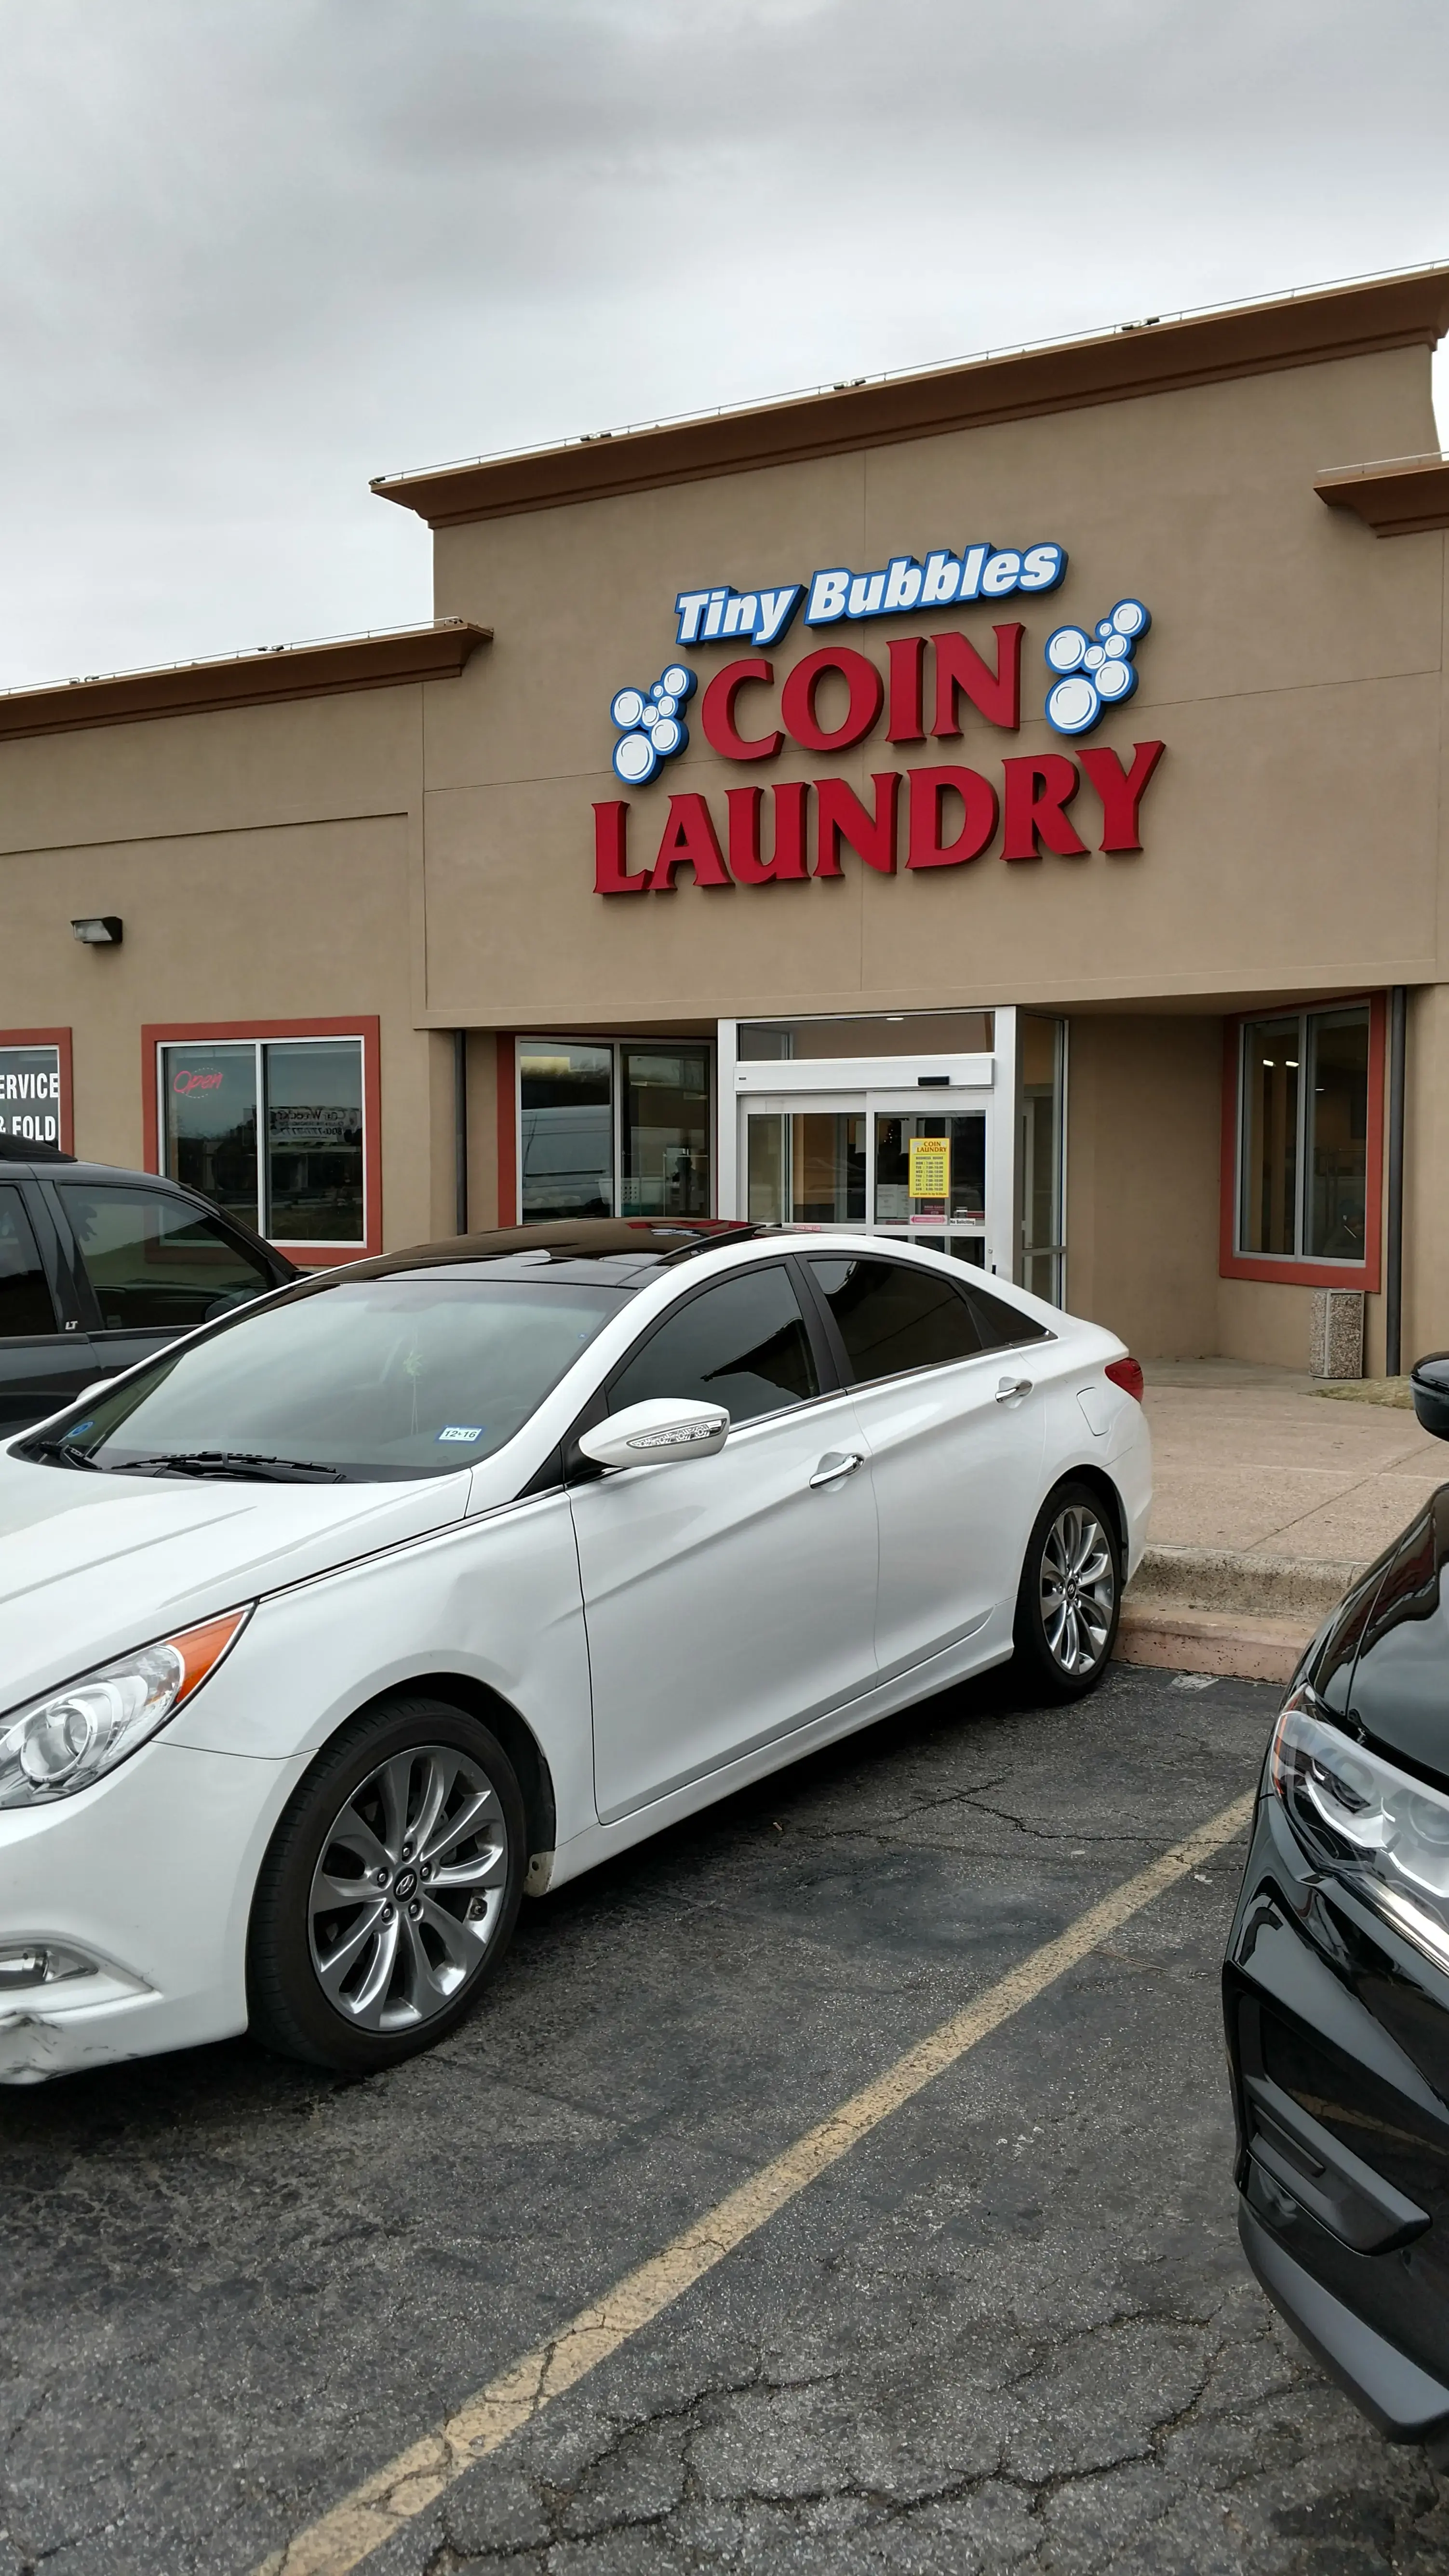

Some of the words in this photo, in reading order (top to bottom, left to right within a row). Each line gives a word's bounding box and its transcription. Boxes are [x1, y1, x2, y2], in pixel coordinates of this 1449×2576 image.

[676, 585, 802, 645] Tiny
[805, 543, 1064, 626] Bubbles
[701, 622, 1025, 760] COIN
[591, 740, 1166, 894] LAUNDRY
[174, 1070, 223, 1095] Open
[13, 1115, 55, 1141] FOLD
[65, 1321, 78, 1330] LT
